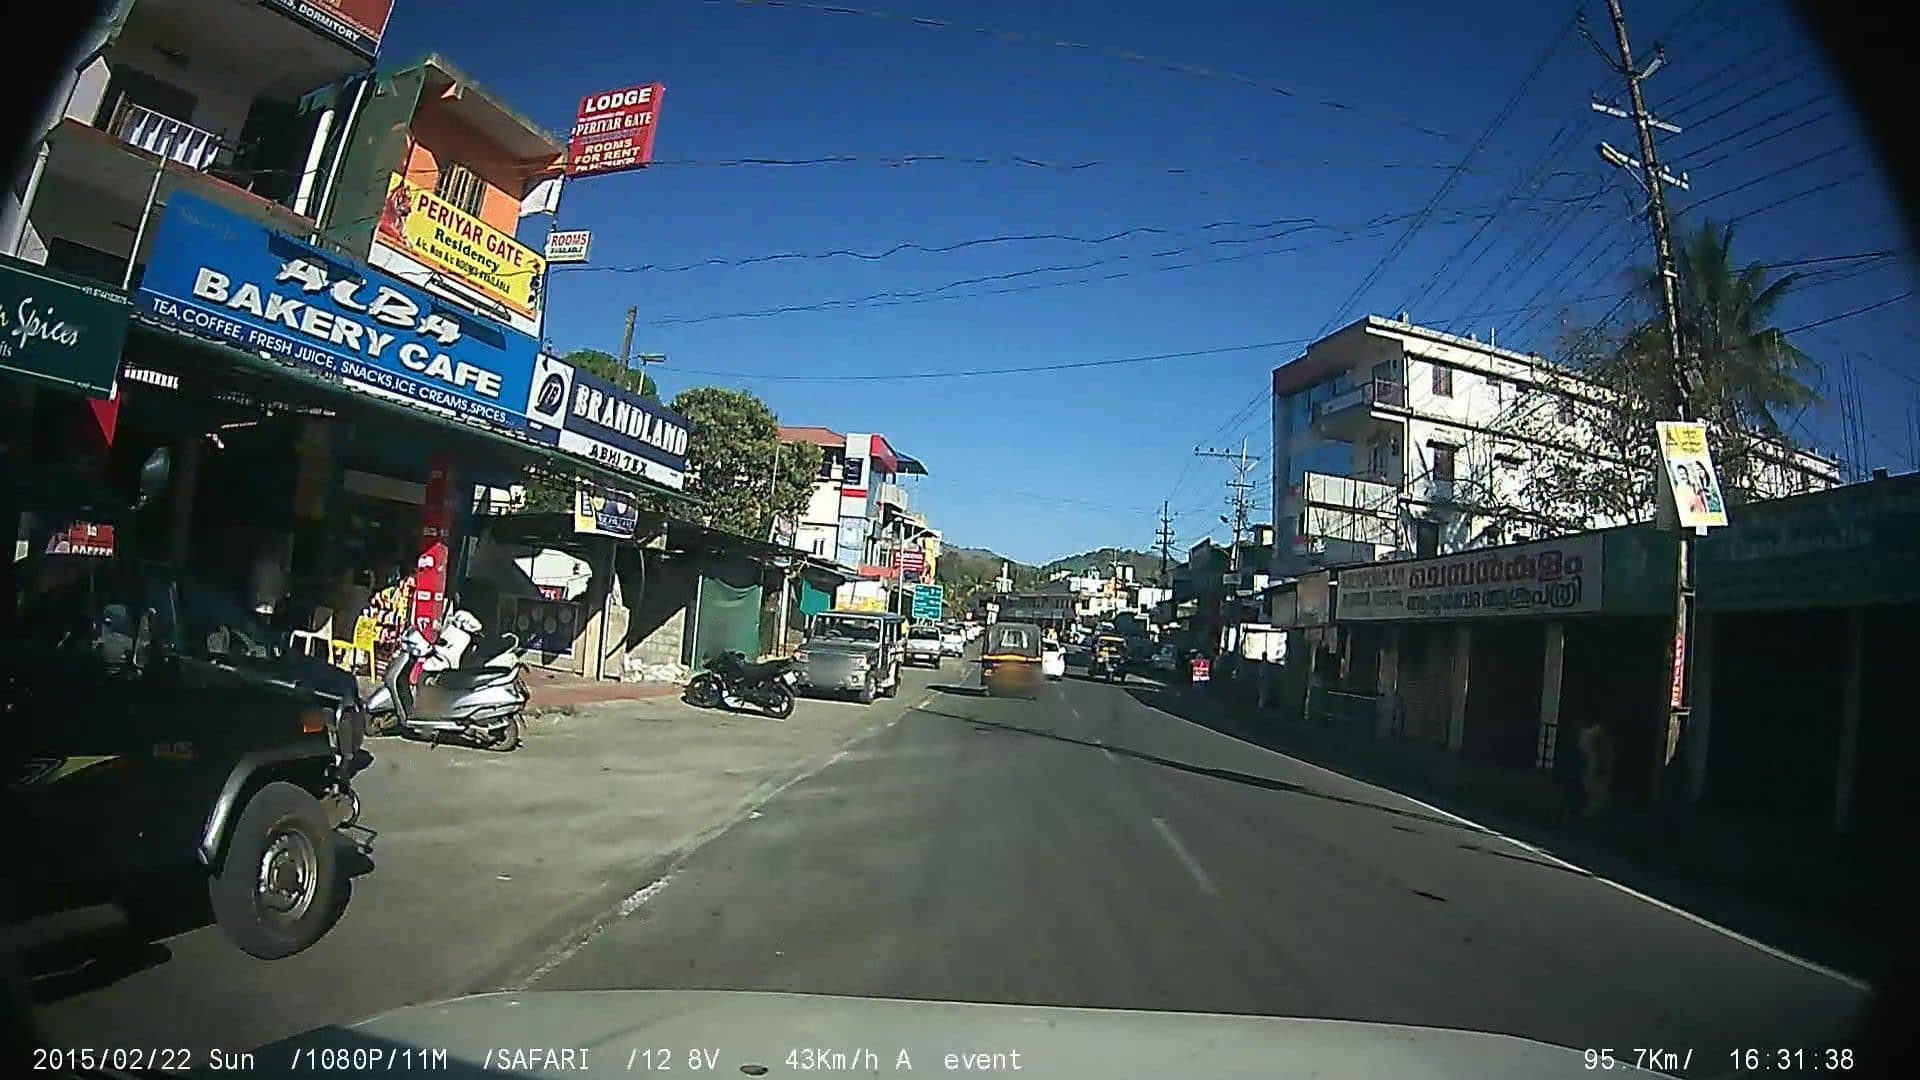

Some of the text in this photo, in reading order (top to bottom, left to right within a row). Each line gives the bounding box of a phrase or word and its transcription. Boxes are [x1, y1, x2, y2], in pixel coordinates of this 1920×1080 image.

[299, 4, 361, 42] DORMITORY
[585, 87, 653, 113] LODGE
[575, 117, 622, 137] PERIYAR
[624, 111, 653, 128] GATE
[574, 153, 601, 165] FOR
[603, 146, 641, 160] RENT
[584, 138, 633, 154] ROOMS
[416, 193, 524, 268] PERIYAR GATE
[550, 233, 588, 247] ROOMS
[434, 226, 501, 273] Residency
[275, 258, 462, 344] ALBA
[11, 297, 79, 348] Spices
[193, 267, 396, 358] BAKERY
[399, 343, 503, 398] CAFE
[248, 330, 293, 356] FRESH
[572, 383, 689, 457] BRANDLAND
[588, 444, 648, 476] ABHI TEX
